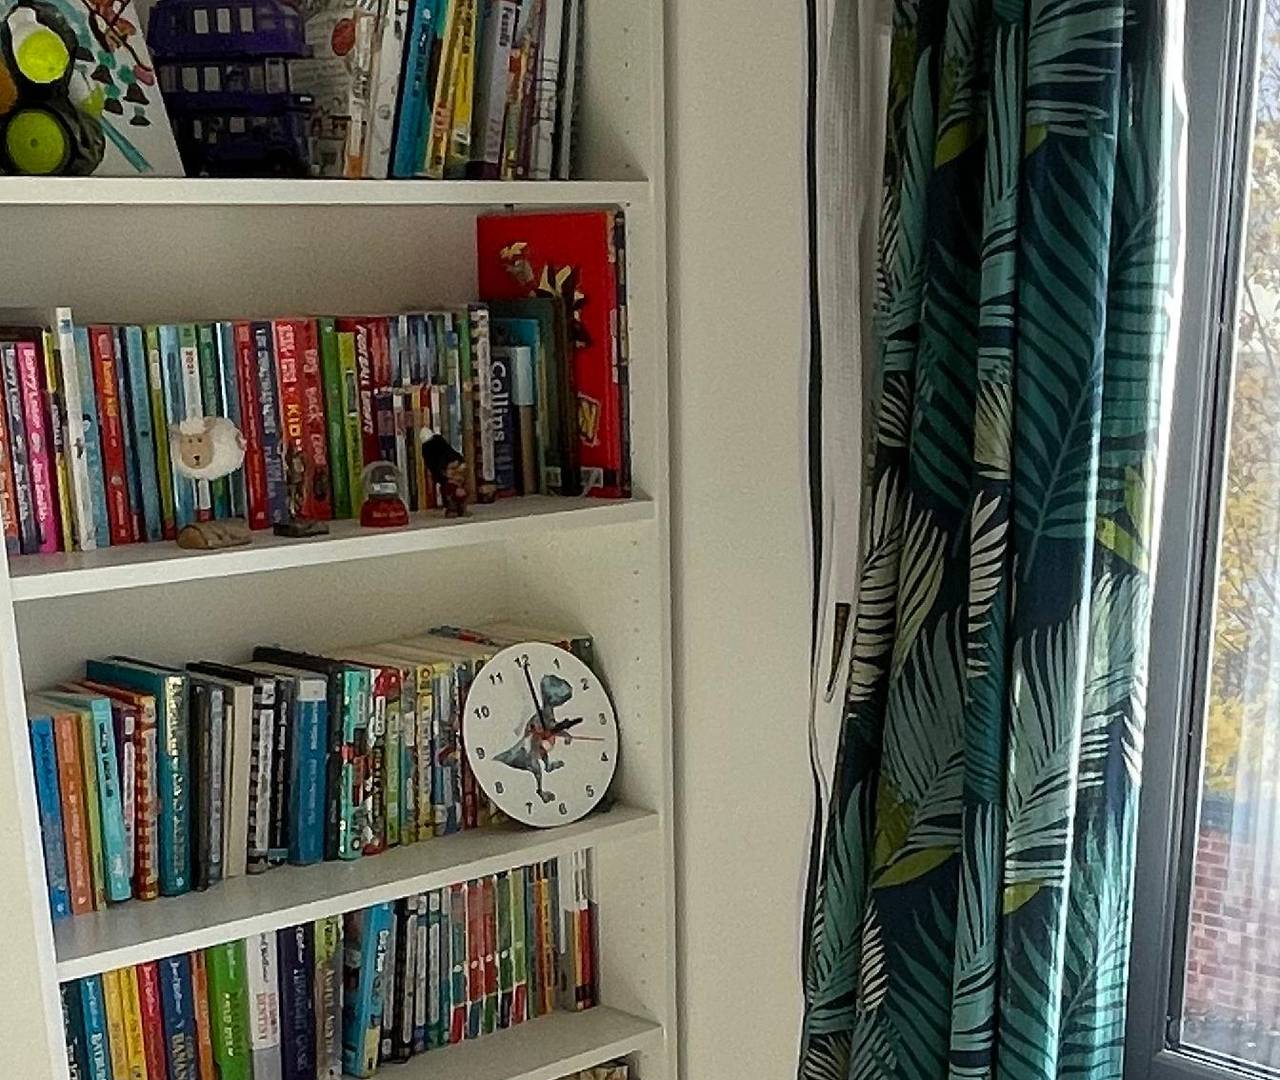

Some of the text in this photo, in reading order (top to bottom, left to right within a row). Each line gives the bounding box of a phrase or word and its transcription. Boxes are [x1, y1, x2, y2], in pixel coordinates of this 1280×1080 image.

[490, 360, 509, 442] Collins
[287, 404, 302, 438] KID
[553, 658, 561, 669] 1
[489, 672, 504, 685] 11
[580, 678, 590, 691] 2
[473, 705, 490, 720] 10
[599, 713, 607, 725] 3
[475, 747, 485, 760] 9
[600, 752, 609, 763] 4
[586, 785, 594, 798] 5
[525, 802, 533, 815] 7
[558, 803, 567, 815] 6
